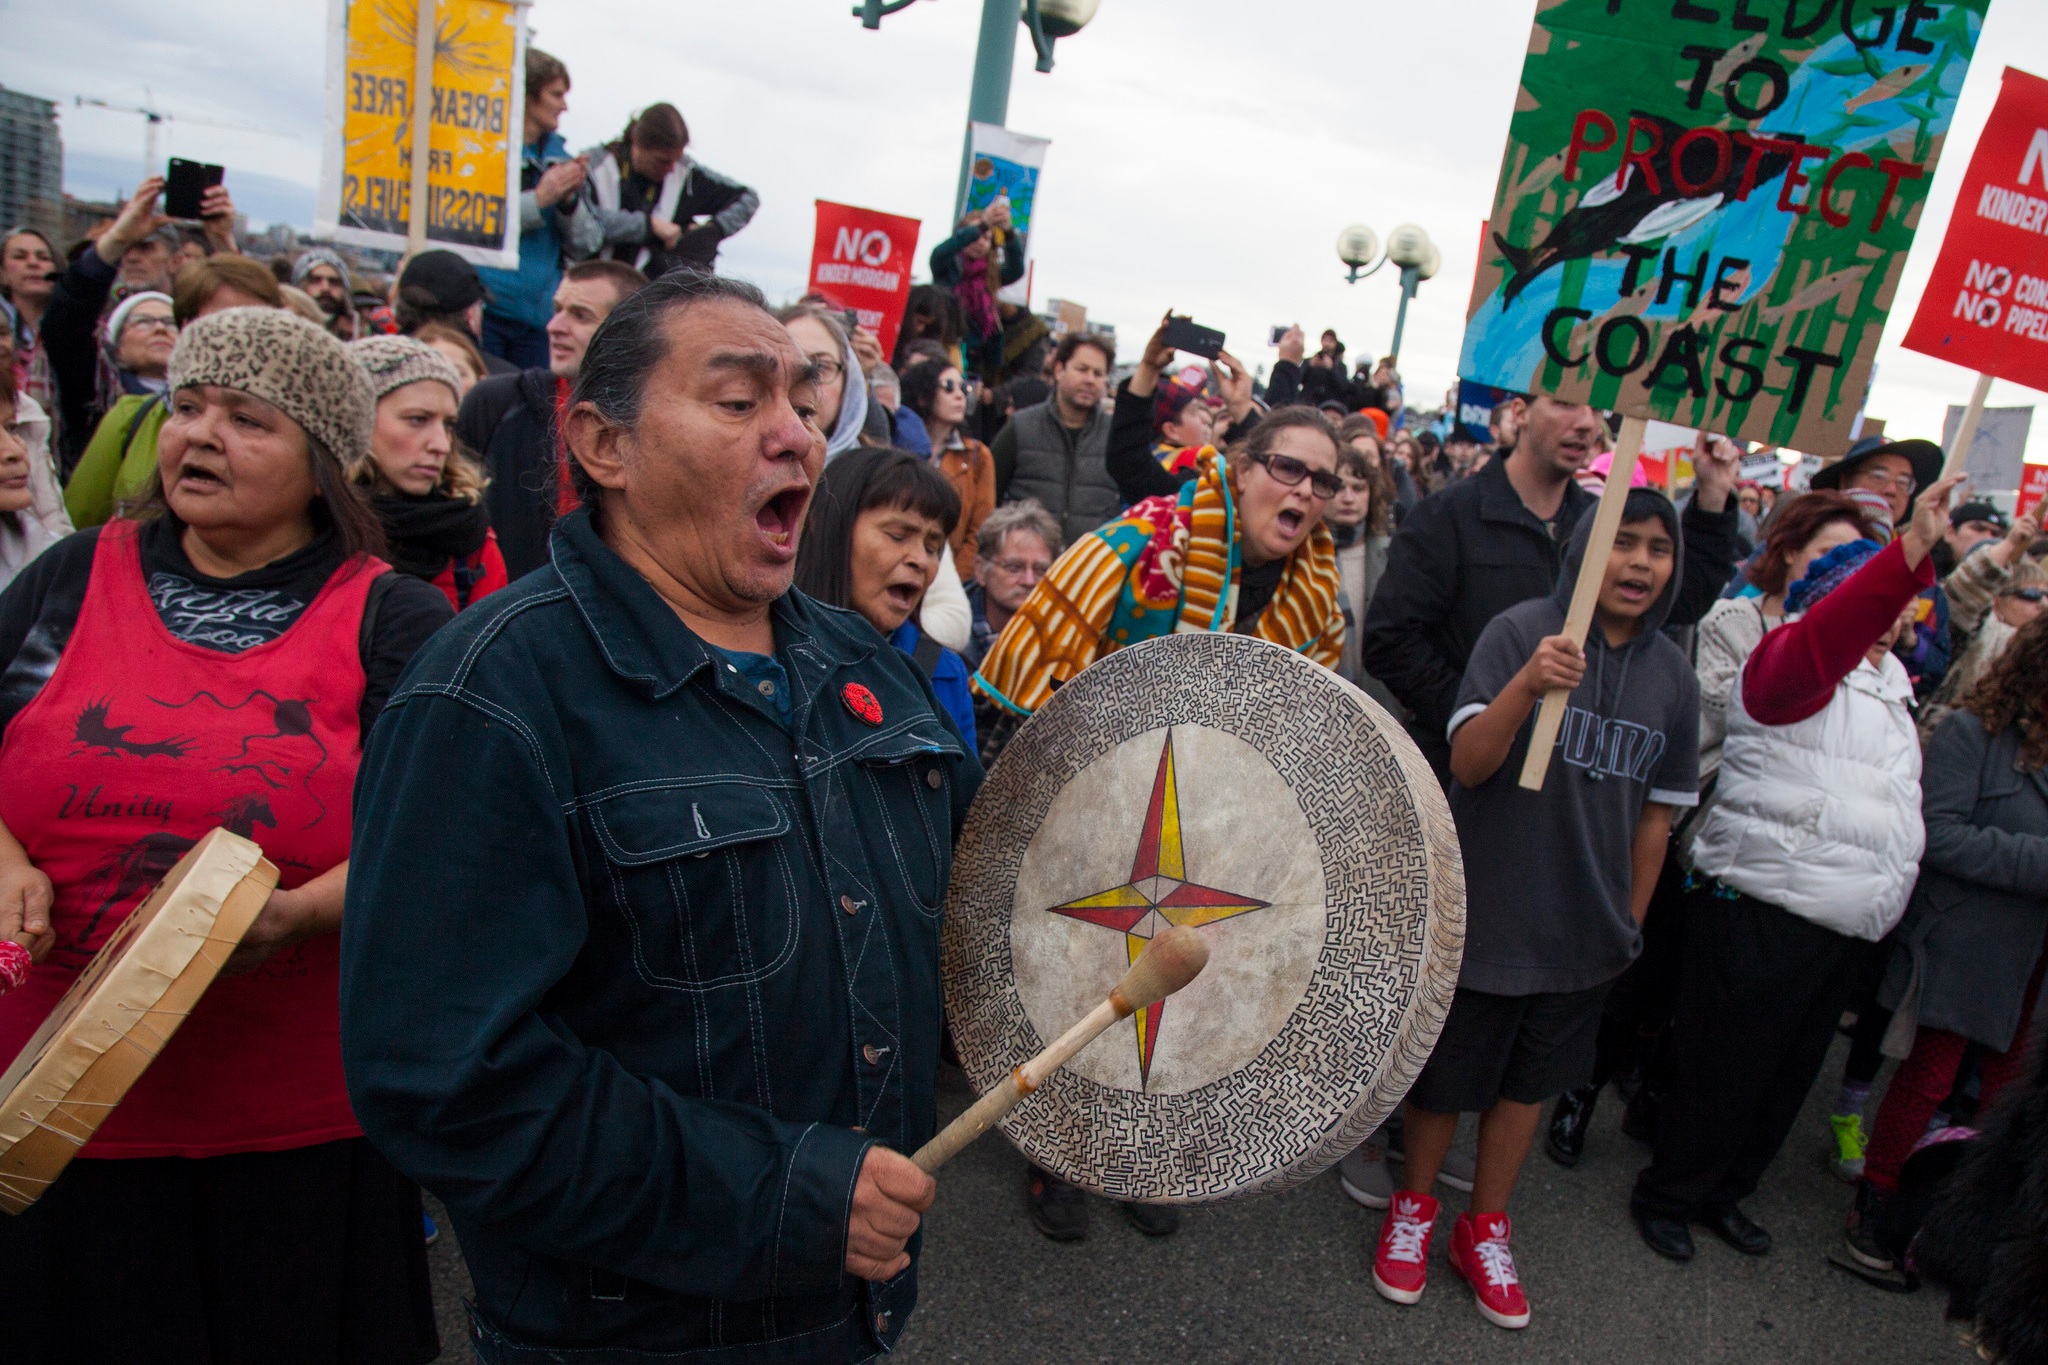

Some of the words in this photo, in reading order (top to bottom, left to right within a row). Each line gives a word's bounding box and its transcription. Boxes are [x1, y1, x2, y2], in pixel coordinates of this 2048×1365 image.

[1606, 0, 1939, 55] DGE
[1680, 45, 1790, 120] TO
[1563, 108, 1925, 234] PROTECT
[2017, 127, 2048, 193] N
[1976, 183, 2047, 235] KINDER
[833, 226, 892, 267] NO
[1618, 243, 1750, 312] THE
[1963, 258, 2012, 298] NO
[2014, 274, 2048, 311] CON
[1952, 289, 2001, 329] NO
[2003, 304, 2048, 343] PIPEL
[1541, 306, 1843, 414] COAST
[58, 783, 174, 825] Unity
